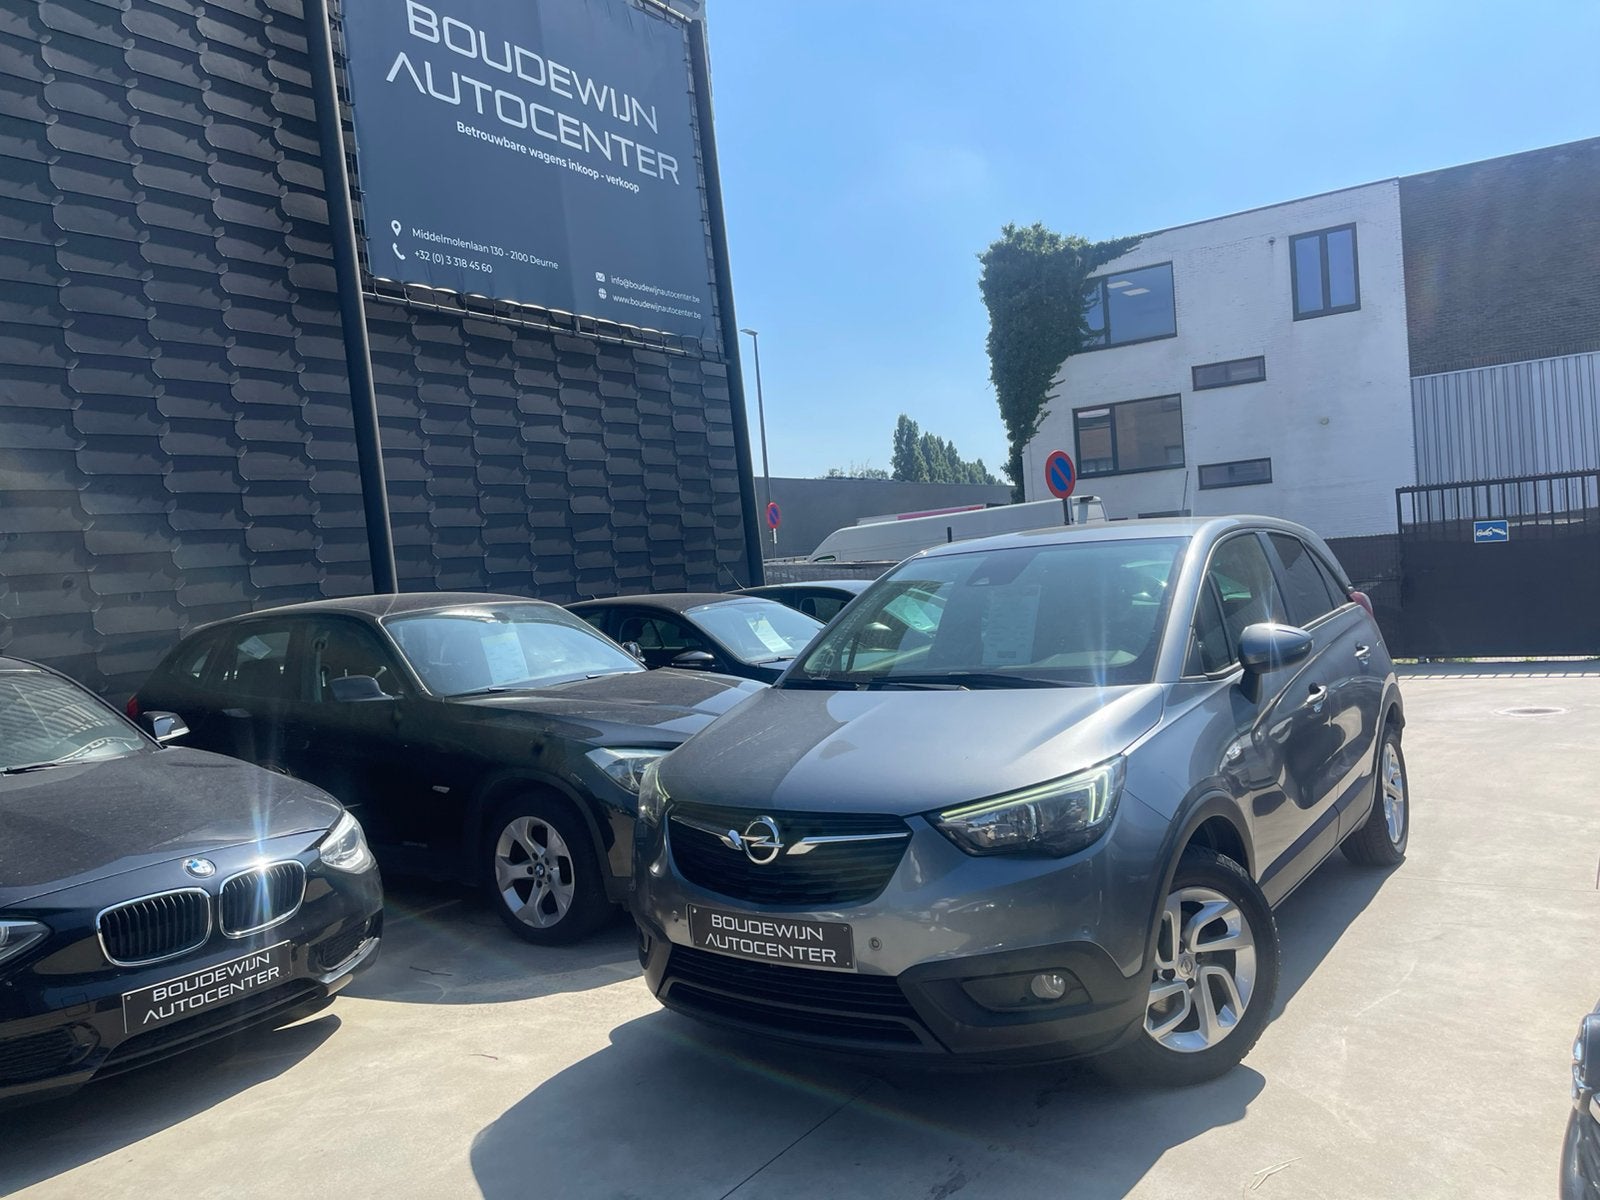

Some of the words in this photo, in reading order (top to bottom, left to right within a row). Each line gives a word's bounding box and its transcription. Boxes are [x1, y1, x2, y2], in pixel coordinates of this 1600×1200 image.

[406, 0, 658, 134] BOUDEWIJN
[386, 51, 680, 185] AUTOCENTER
[456, 121, 527, 154] Betrouwbare
[528, 147, 567, 168] wagens
[568, 158, 599, 180] inkoop
[605, 173, 640, 194] verkoop
[412, 228, 489, 253] Middelmolenlaan
[490, 245, 504, 257] 130
[510, 250, 529, 263] 2100
[530, 255, 559, 270] Deurne
[414, 250, 431, 262] +32
[432, 252, 445, 266] (0)
[446, 255, 452, 265] 3
[453, 256, 468, 268] 318
[469, 260, 480, 271] 45
[481, 263, 493, 274] 60
[610, 275, 701, 304] info@boudewijnautocenter.be
[612, 294, 702, 320] www.boudewijnautocenter.be
[705, 932, 837, 964] AUTOCENTER
[711, 913, 824, 942] BOUDEWIJN
[142, 966, 280, 1025] AUTOCENTER
[152, 952, 270, 1003] BOUDEWIJN
